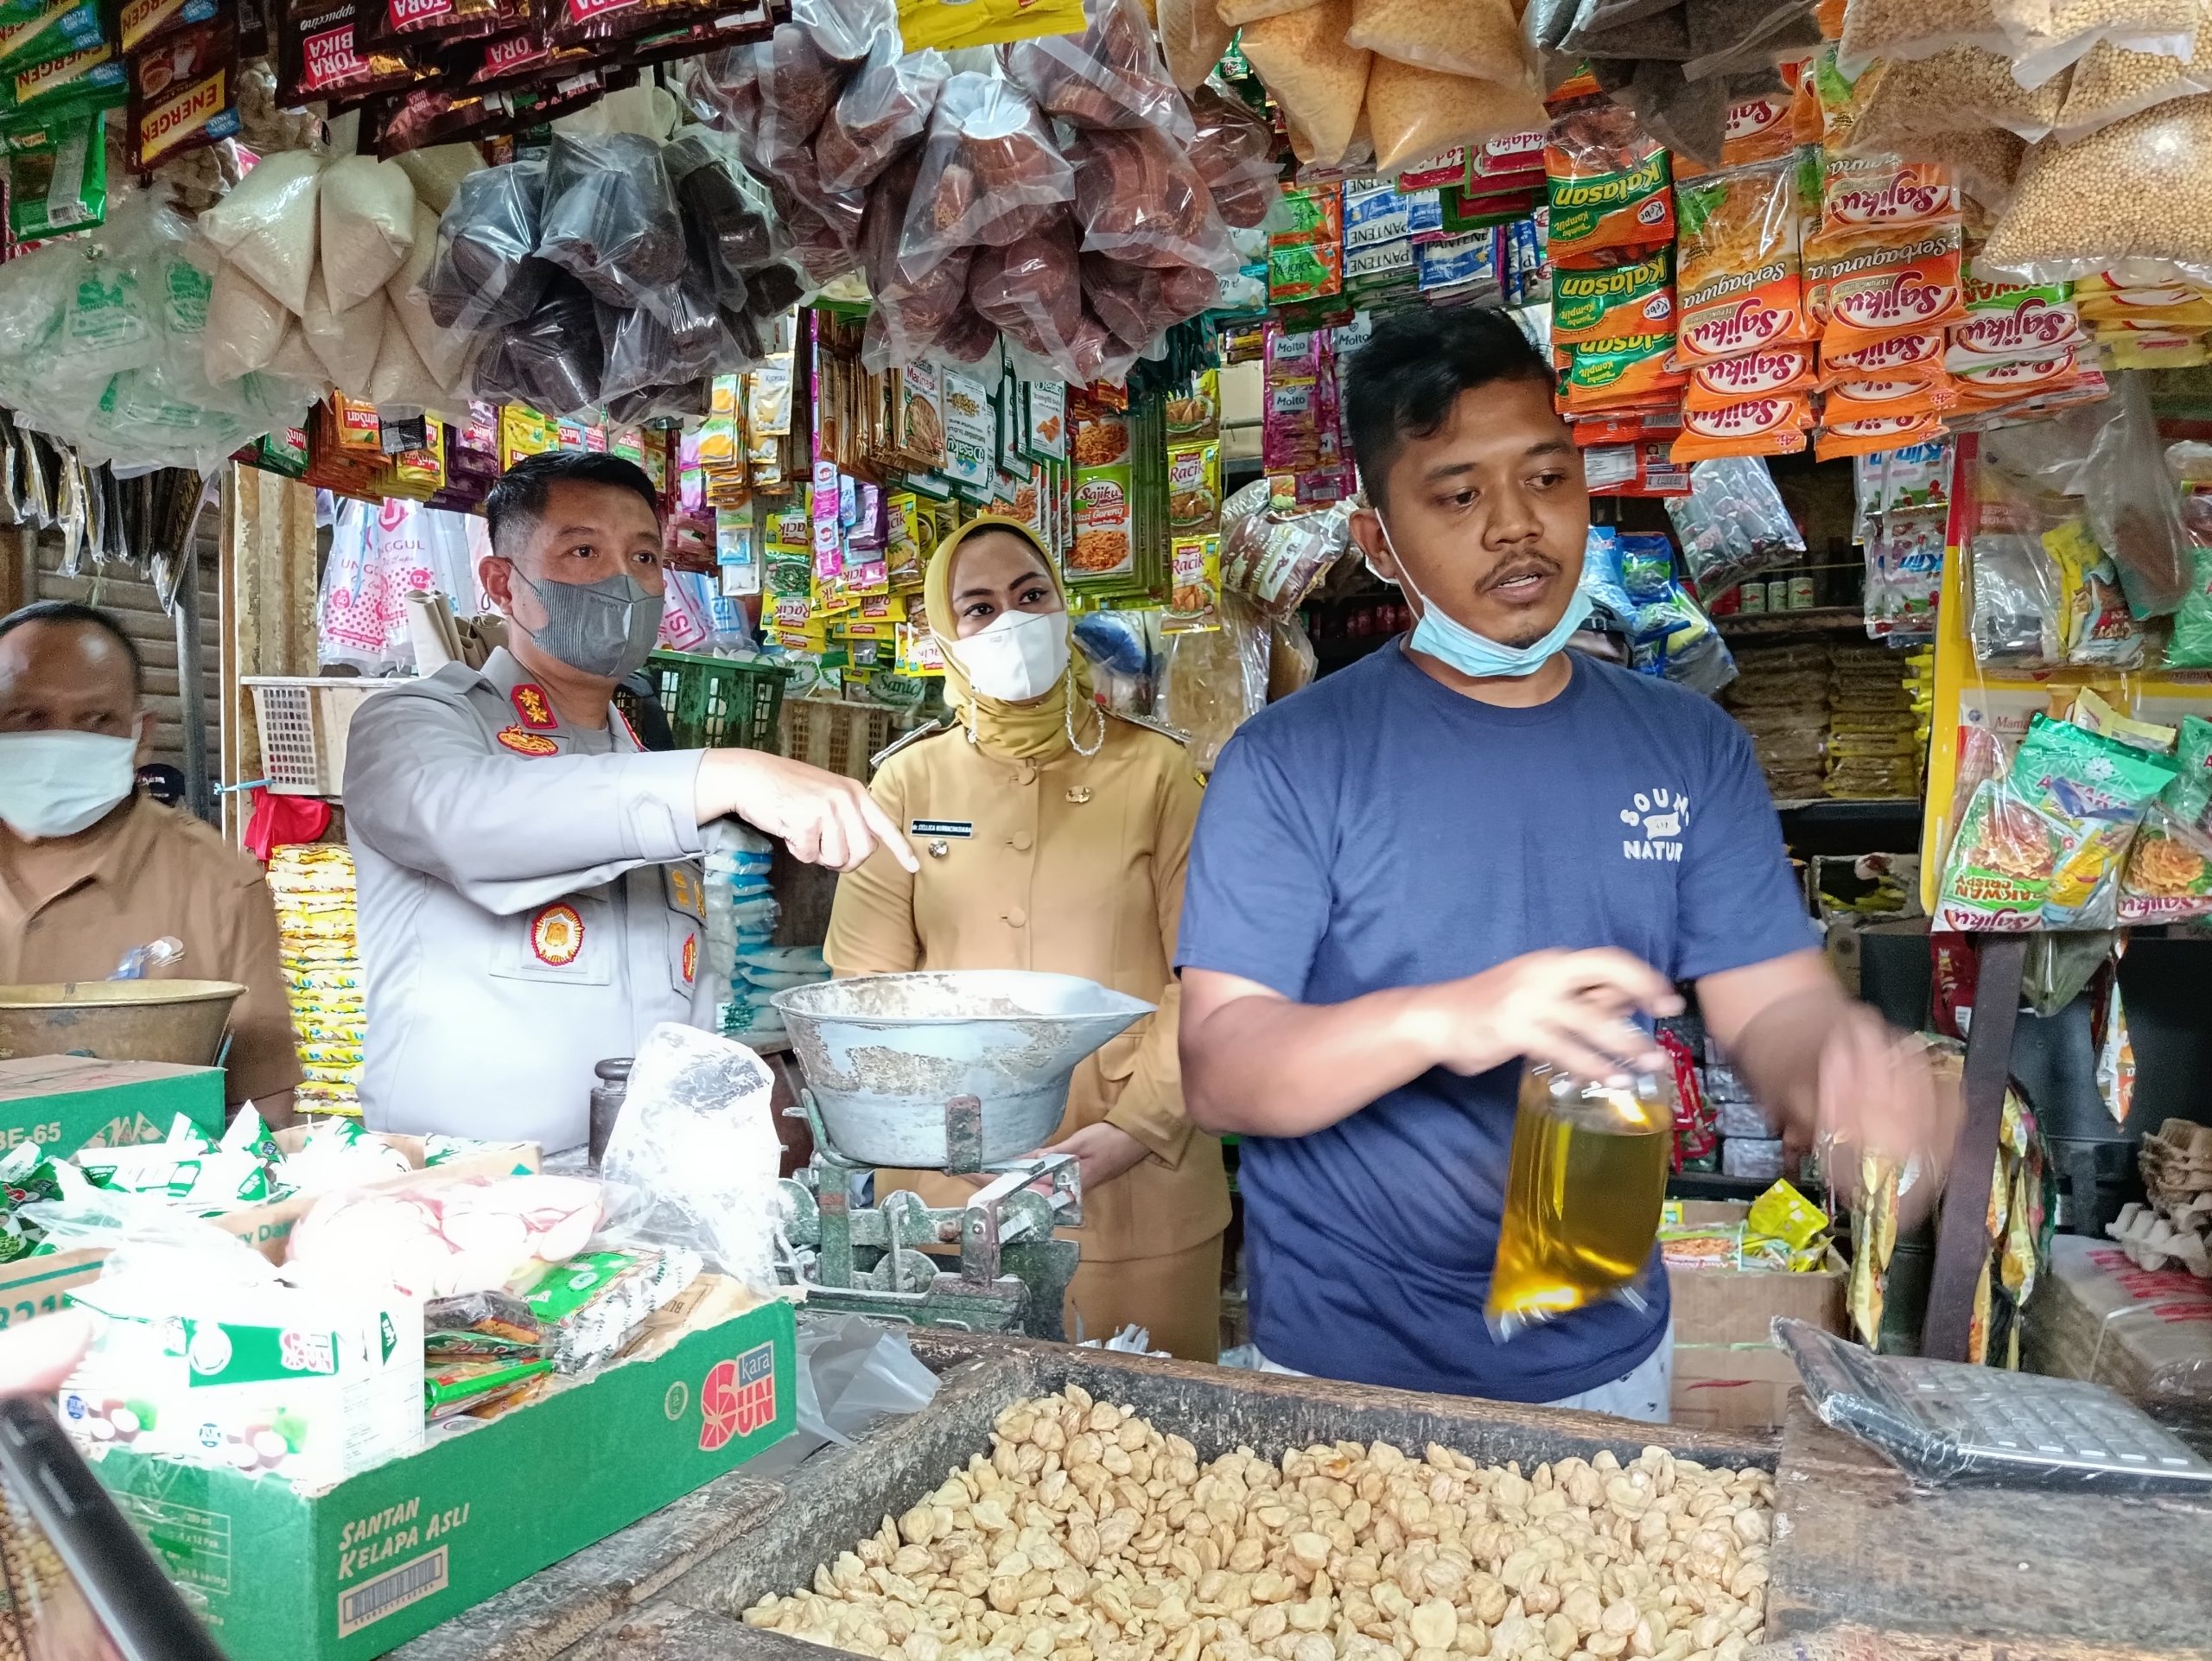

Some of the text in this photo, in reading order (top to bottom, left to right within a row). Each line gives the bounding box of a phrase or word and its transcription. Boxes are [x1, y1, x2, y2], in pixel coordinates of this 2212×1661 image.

[308, 31, 353, 59] BIKA
[491, 36, 533, 63] ORA
[309, 50, 364, 78] TORA
[141, 84, 217, 143] ENERGEN
[1555, 161, 1661, 206] Kalasan
[1841, 170, 1937, 217] Sajiku
[1640, 203, 1663, 220] Kobe
[1351, 220, 1408, 245] PANTENE
[1350, 250, 1409, 273] PANTENE
[1832, 238, 1948, 283] Serbaguna
[1561, 257, 1666, 296] Kalasan
[1684, 262, 1786, 309] Serbaguna
[1645, 299, 1668, 316] Kobe
[1845, 270, 1942, 319] Sajiku
[1694, 298, 1778, 347] Sajiku
[1966, 297, 2066, 347] Sajiku
[1277, 340, 1306, 353] Molto
[1339, 333, 1370, 346] Molto
[907, 366, 935, 391] Marinasi
[1707, 350, 1796, 385] Sajiku
[1276, 396, 1306, 406] Molto
[947, 435, 985, 465] Desaku
[1170, 460, 1205, 483] Racik
[1080, 486, 1119, 508] Sajiku
[1092, 506, 1124, 519] Goreng
[1173, 553, 1205, 575] Racik
[665, 608, 693, 639] ISI
[775, 599, 810, 620] Racik
[1955, 876, 2014, 890] CRISPY
[741, 1352, 772, 1381] kara
[698, 1359, 777, 1452] SUN
[338, 1496, 421, 1552] SANTAN
[338, 1502, 470, 1581] KELAPA ASLI
